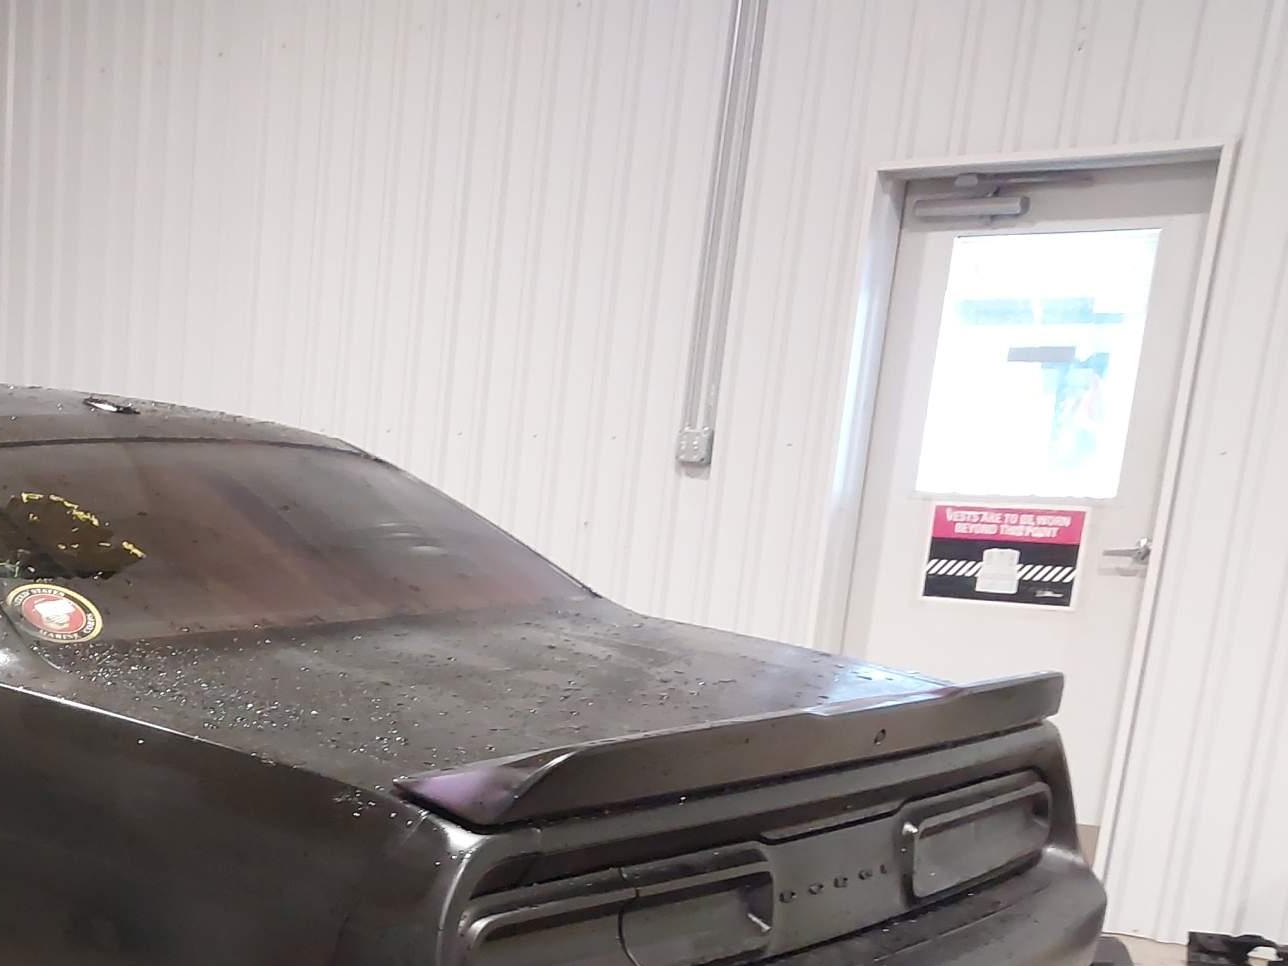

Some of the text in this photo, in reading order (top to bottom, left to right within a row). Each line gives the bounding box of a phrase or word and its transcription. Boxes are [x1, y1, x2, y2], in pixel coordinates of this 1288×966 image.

[945, 507, 980, 522] VESTS
[980, 511, 1002, 524] ARE
[1004, 513, 1018, 524] TO
[1036, 515, 1072, 527] WORN
[954, 523, 1060, 537] BEYOND THIS POINT
[30, 588, 65, 597] STATES
[39, 612, 96, 640] MARINE CORPS
